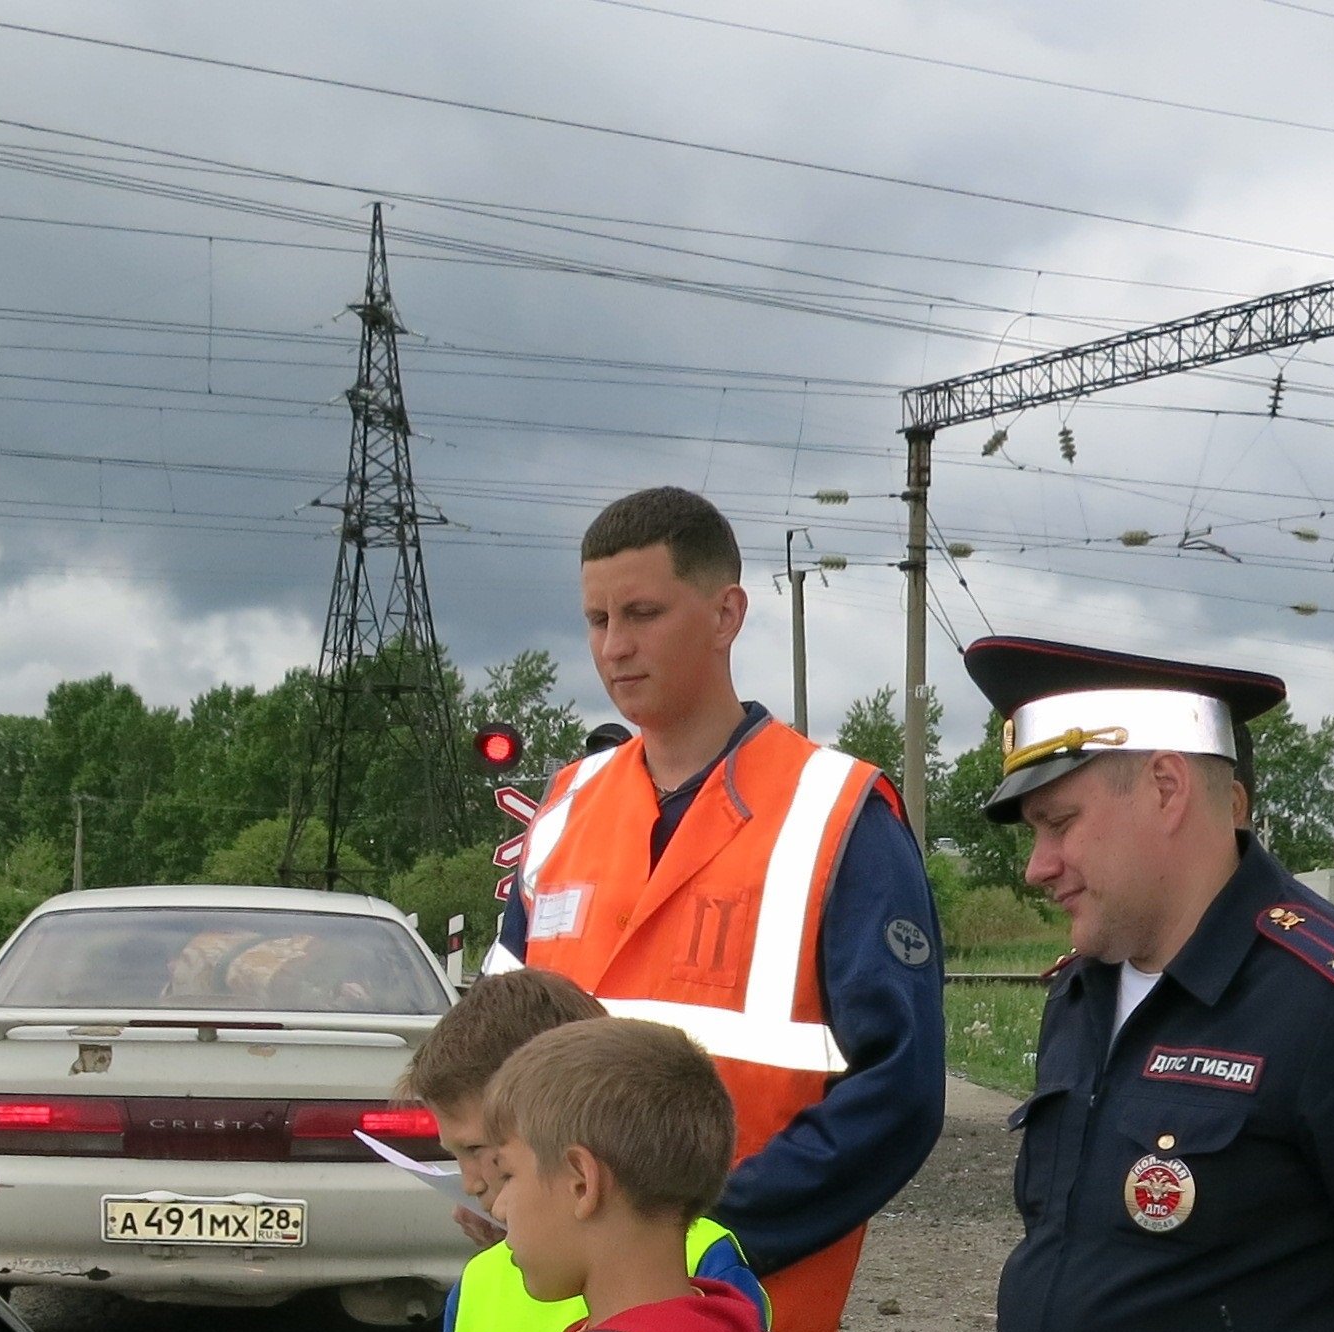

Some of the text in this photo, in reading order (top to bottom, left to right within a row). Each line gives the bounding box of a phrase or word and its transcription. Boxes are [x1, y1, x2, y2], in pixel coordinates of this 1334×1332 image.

[1149, 1054, 1256, 1084] ДПС ГИБДД
[149, 1119, 266, 1130] CRESTA
[1145, 1202, 1169, 1216] ДПС
[259, 1208, 291, 1230] 28
[258, 1230, 281, 1239] RUS
